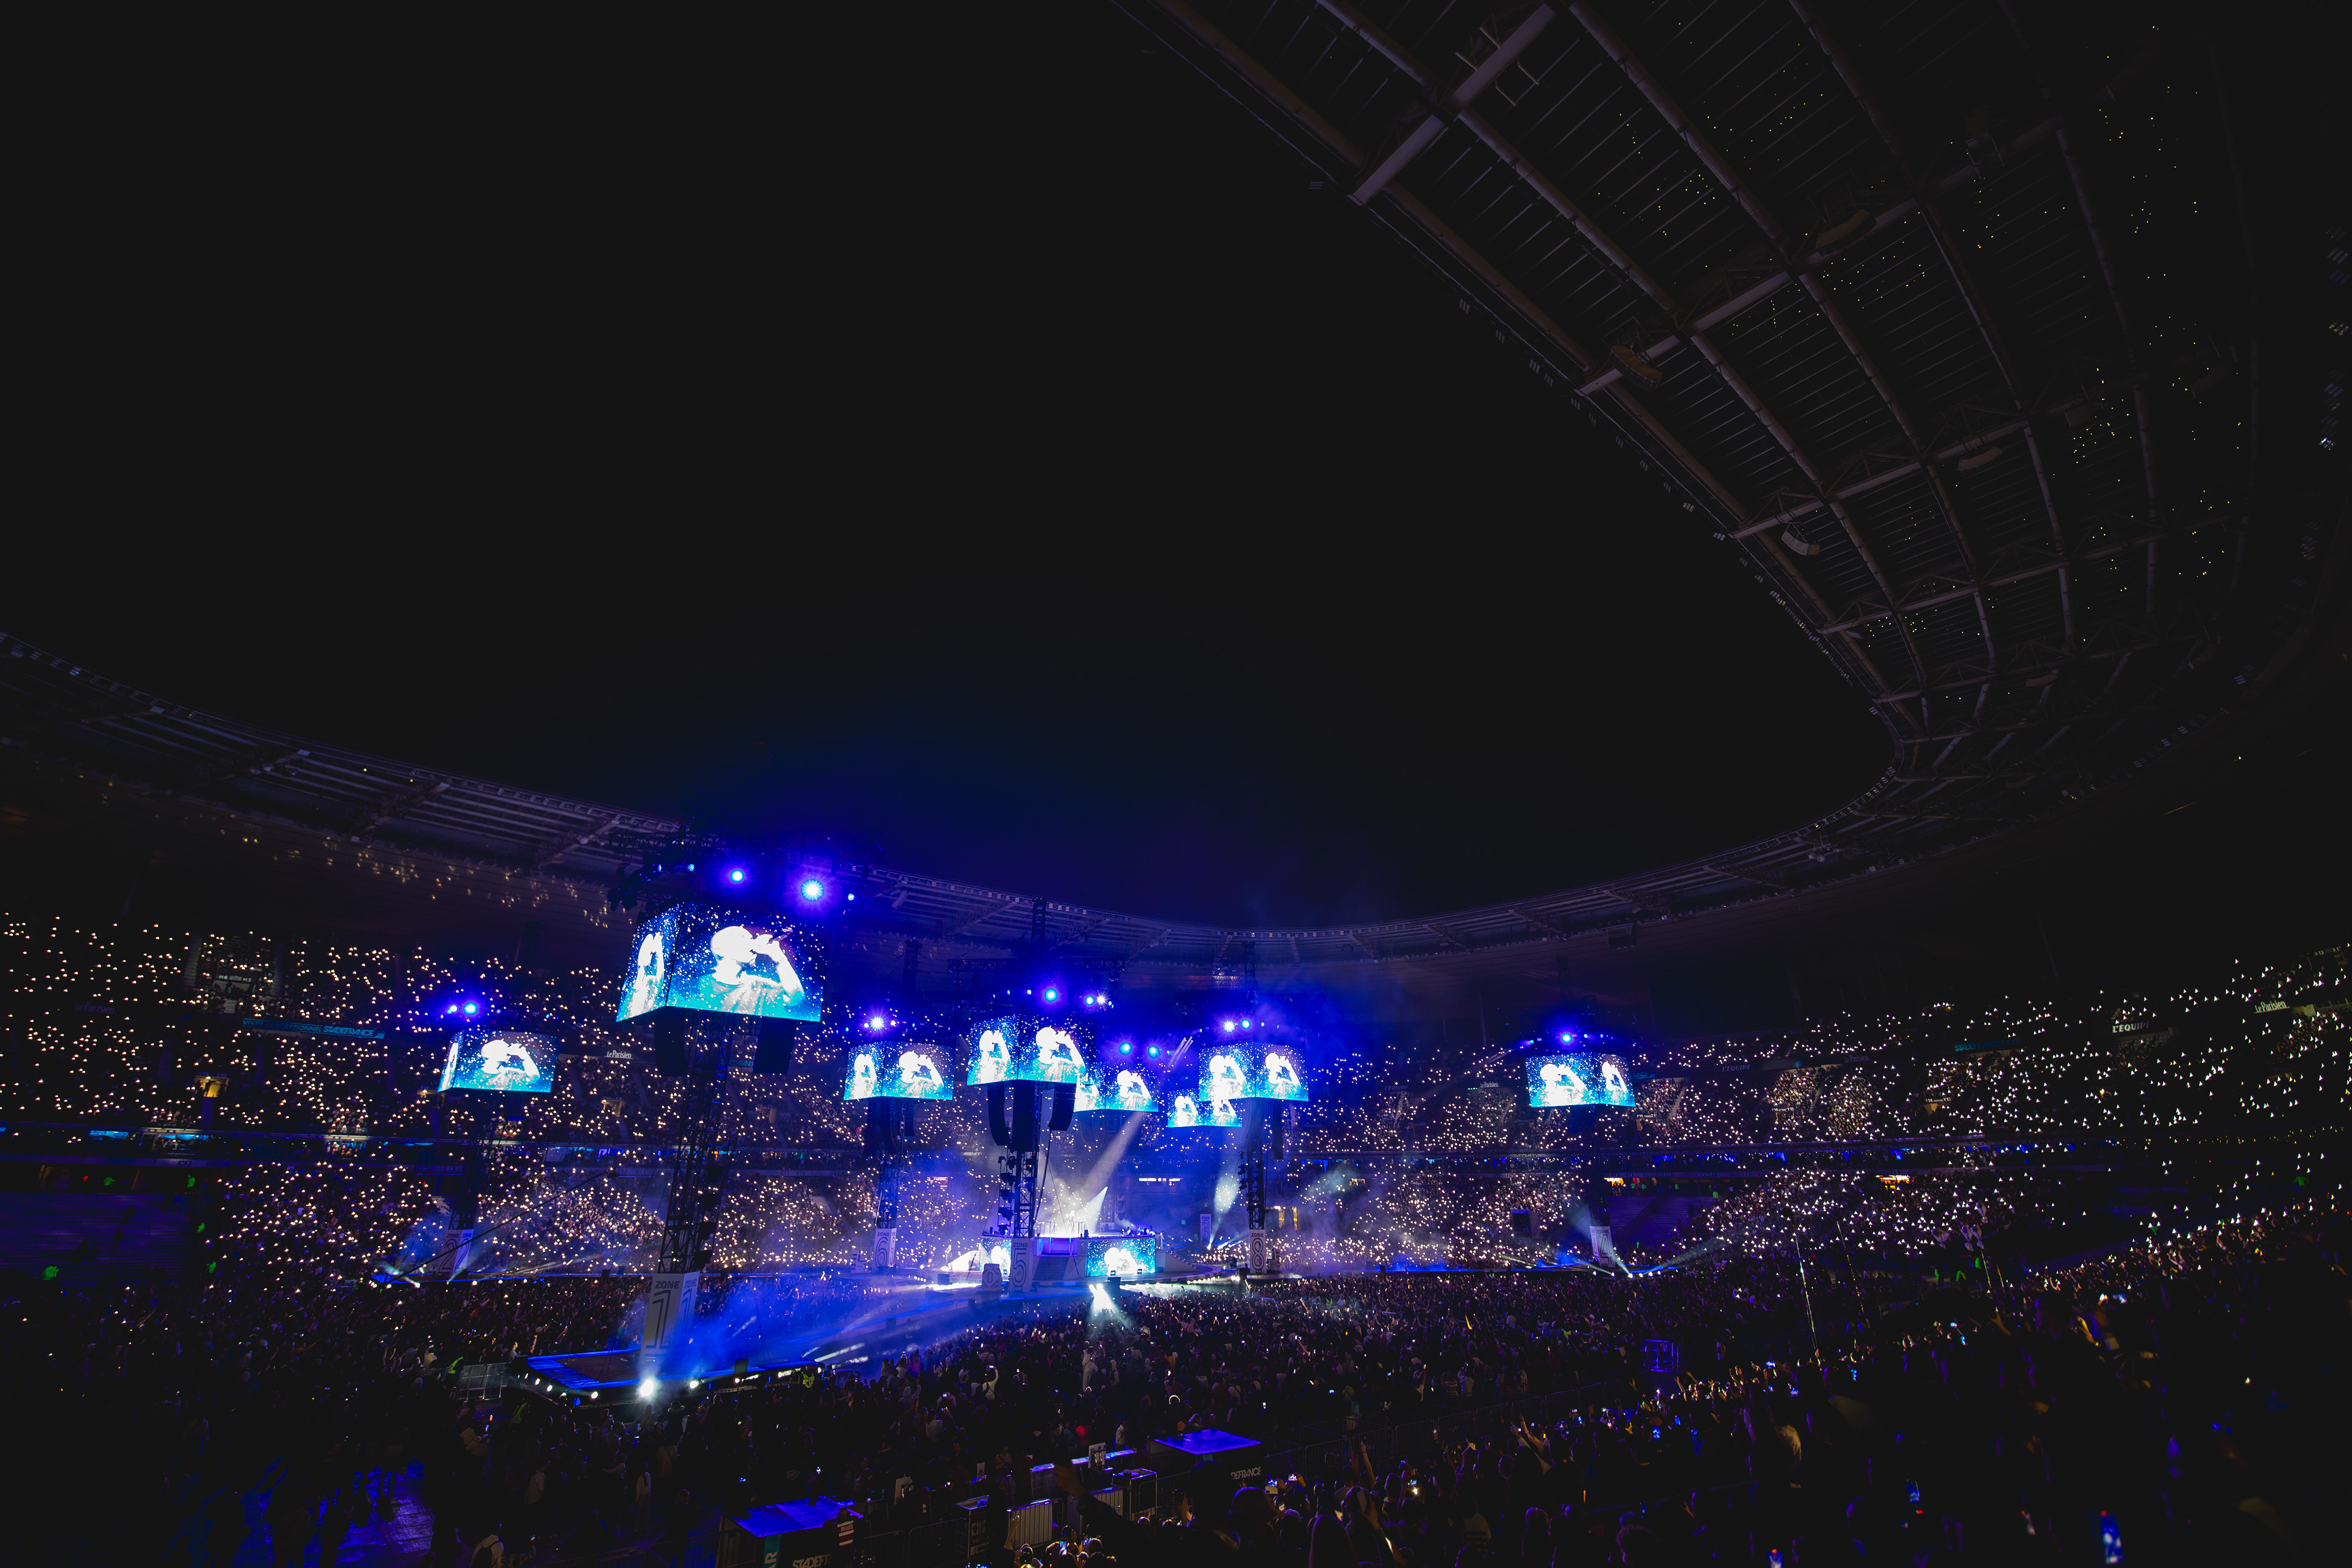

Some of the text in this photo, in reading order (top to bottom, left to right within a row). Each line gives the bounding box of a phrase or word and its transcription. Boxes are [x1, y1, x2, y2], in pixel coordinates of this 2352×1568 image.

[83, 1001, 116, 1015] Parisien
[2254, 1000, 2287, 1013] Le Parisien
[612, 1050, 632, 1059] Parisien
[439, 1238, 458, 1273] 2
[876, 1237, 888, 1269] 6
[1251, 1237, 1264, 1270] 8
[1600, 1234, 1613, 1267] 4
[1013, 1248, 1027, 1287] 5
[655, 1280, 680, 1289] ZONE
[684, 1279, 698, 1289] ZONE
[646, 1289, 671, 1350] 1
